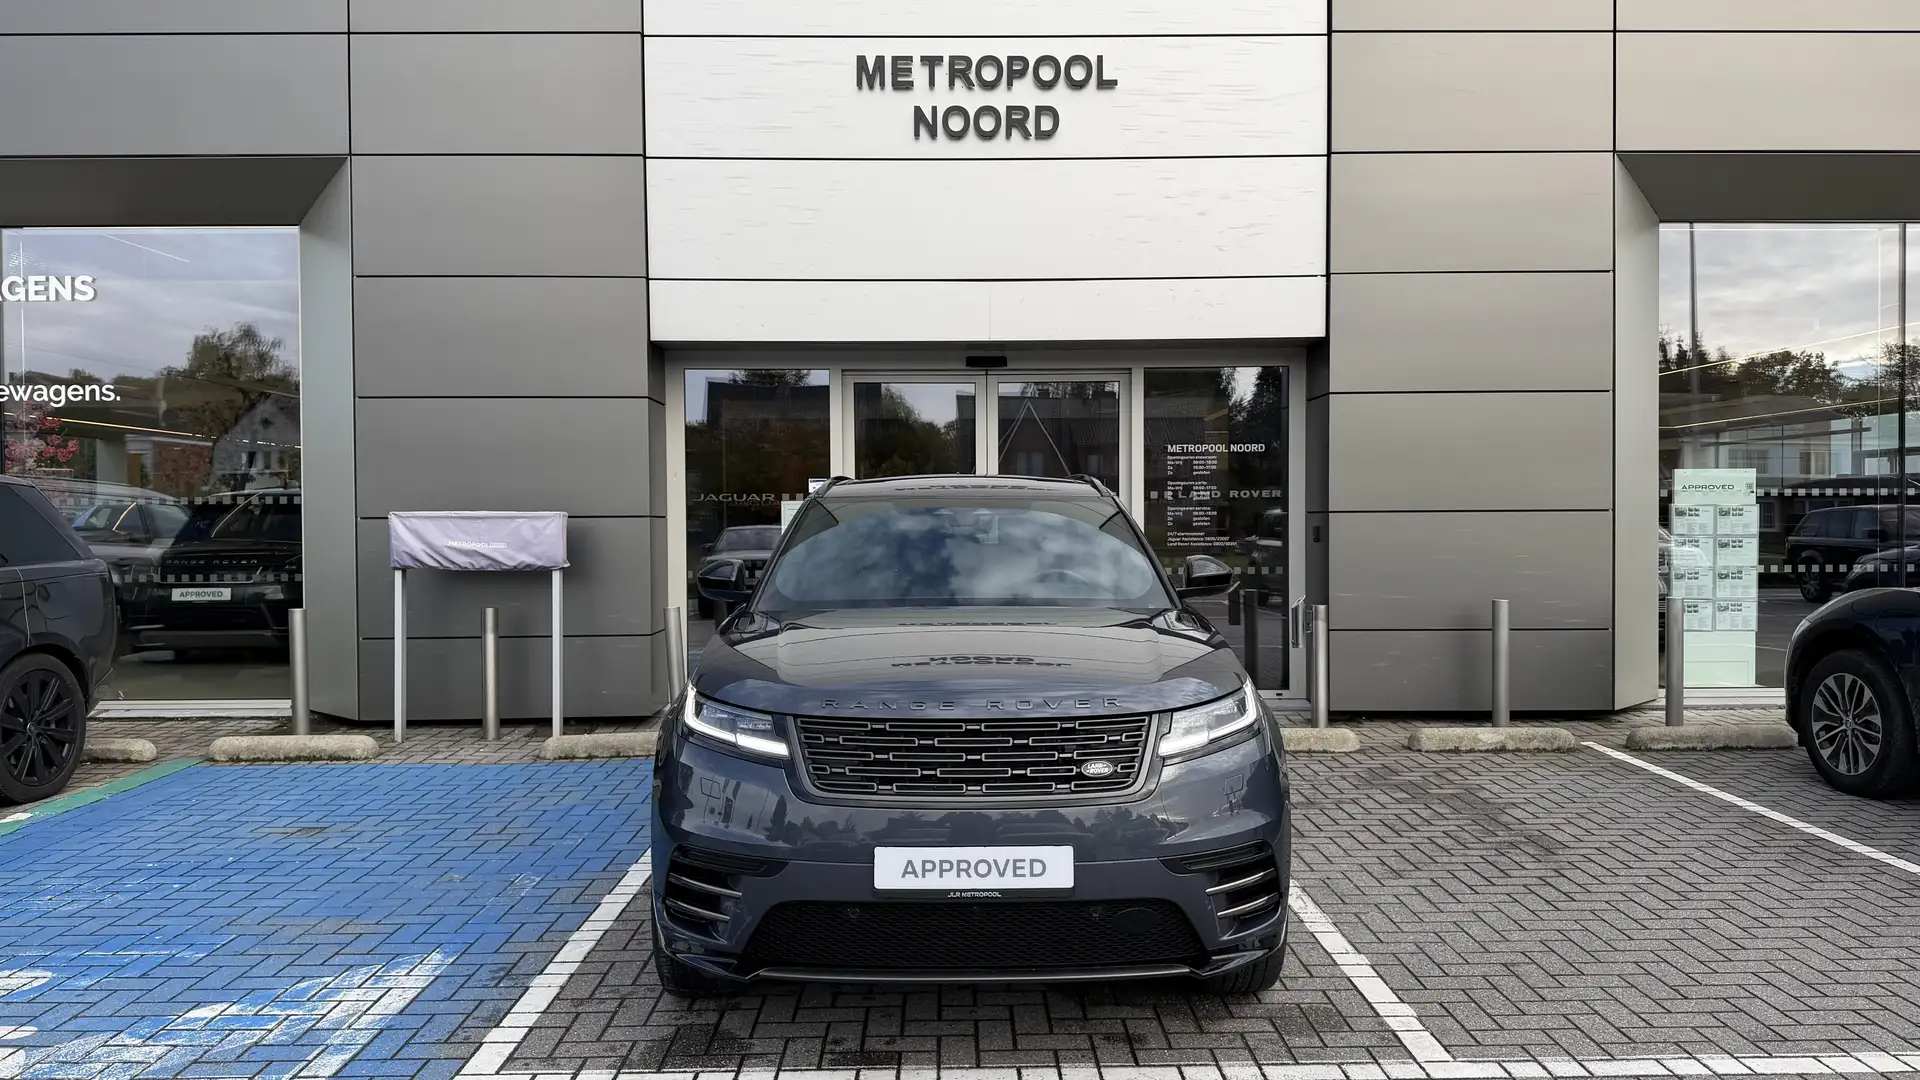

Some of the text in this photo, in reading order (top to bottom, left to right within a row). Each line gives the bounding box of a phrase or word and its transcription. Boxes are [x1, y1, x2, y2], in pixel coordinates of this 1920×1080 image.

[856, 54, 1118, 90] METROPOOL
[913, 104, 1060, 140] NOORD
[0, 275, 96, 302] GENS
[0, 383, 121, 407] ewagens.
[1167, 443, 1266, 453] METROPOOL NOORD
[693, 493, 775, 502] JAGUAR
[1229, 490, 1282, 498] ROVER
[179, 590, 223, 598] APPROVED
[821, 698, 1122, 711] RANGE ROVER
[901, 858, 1047, 879] APPROVED
